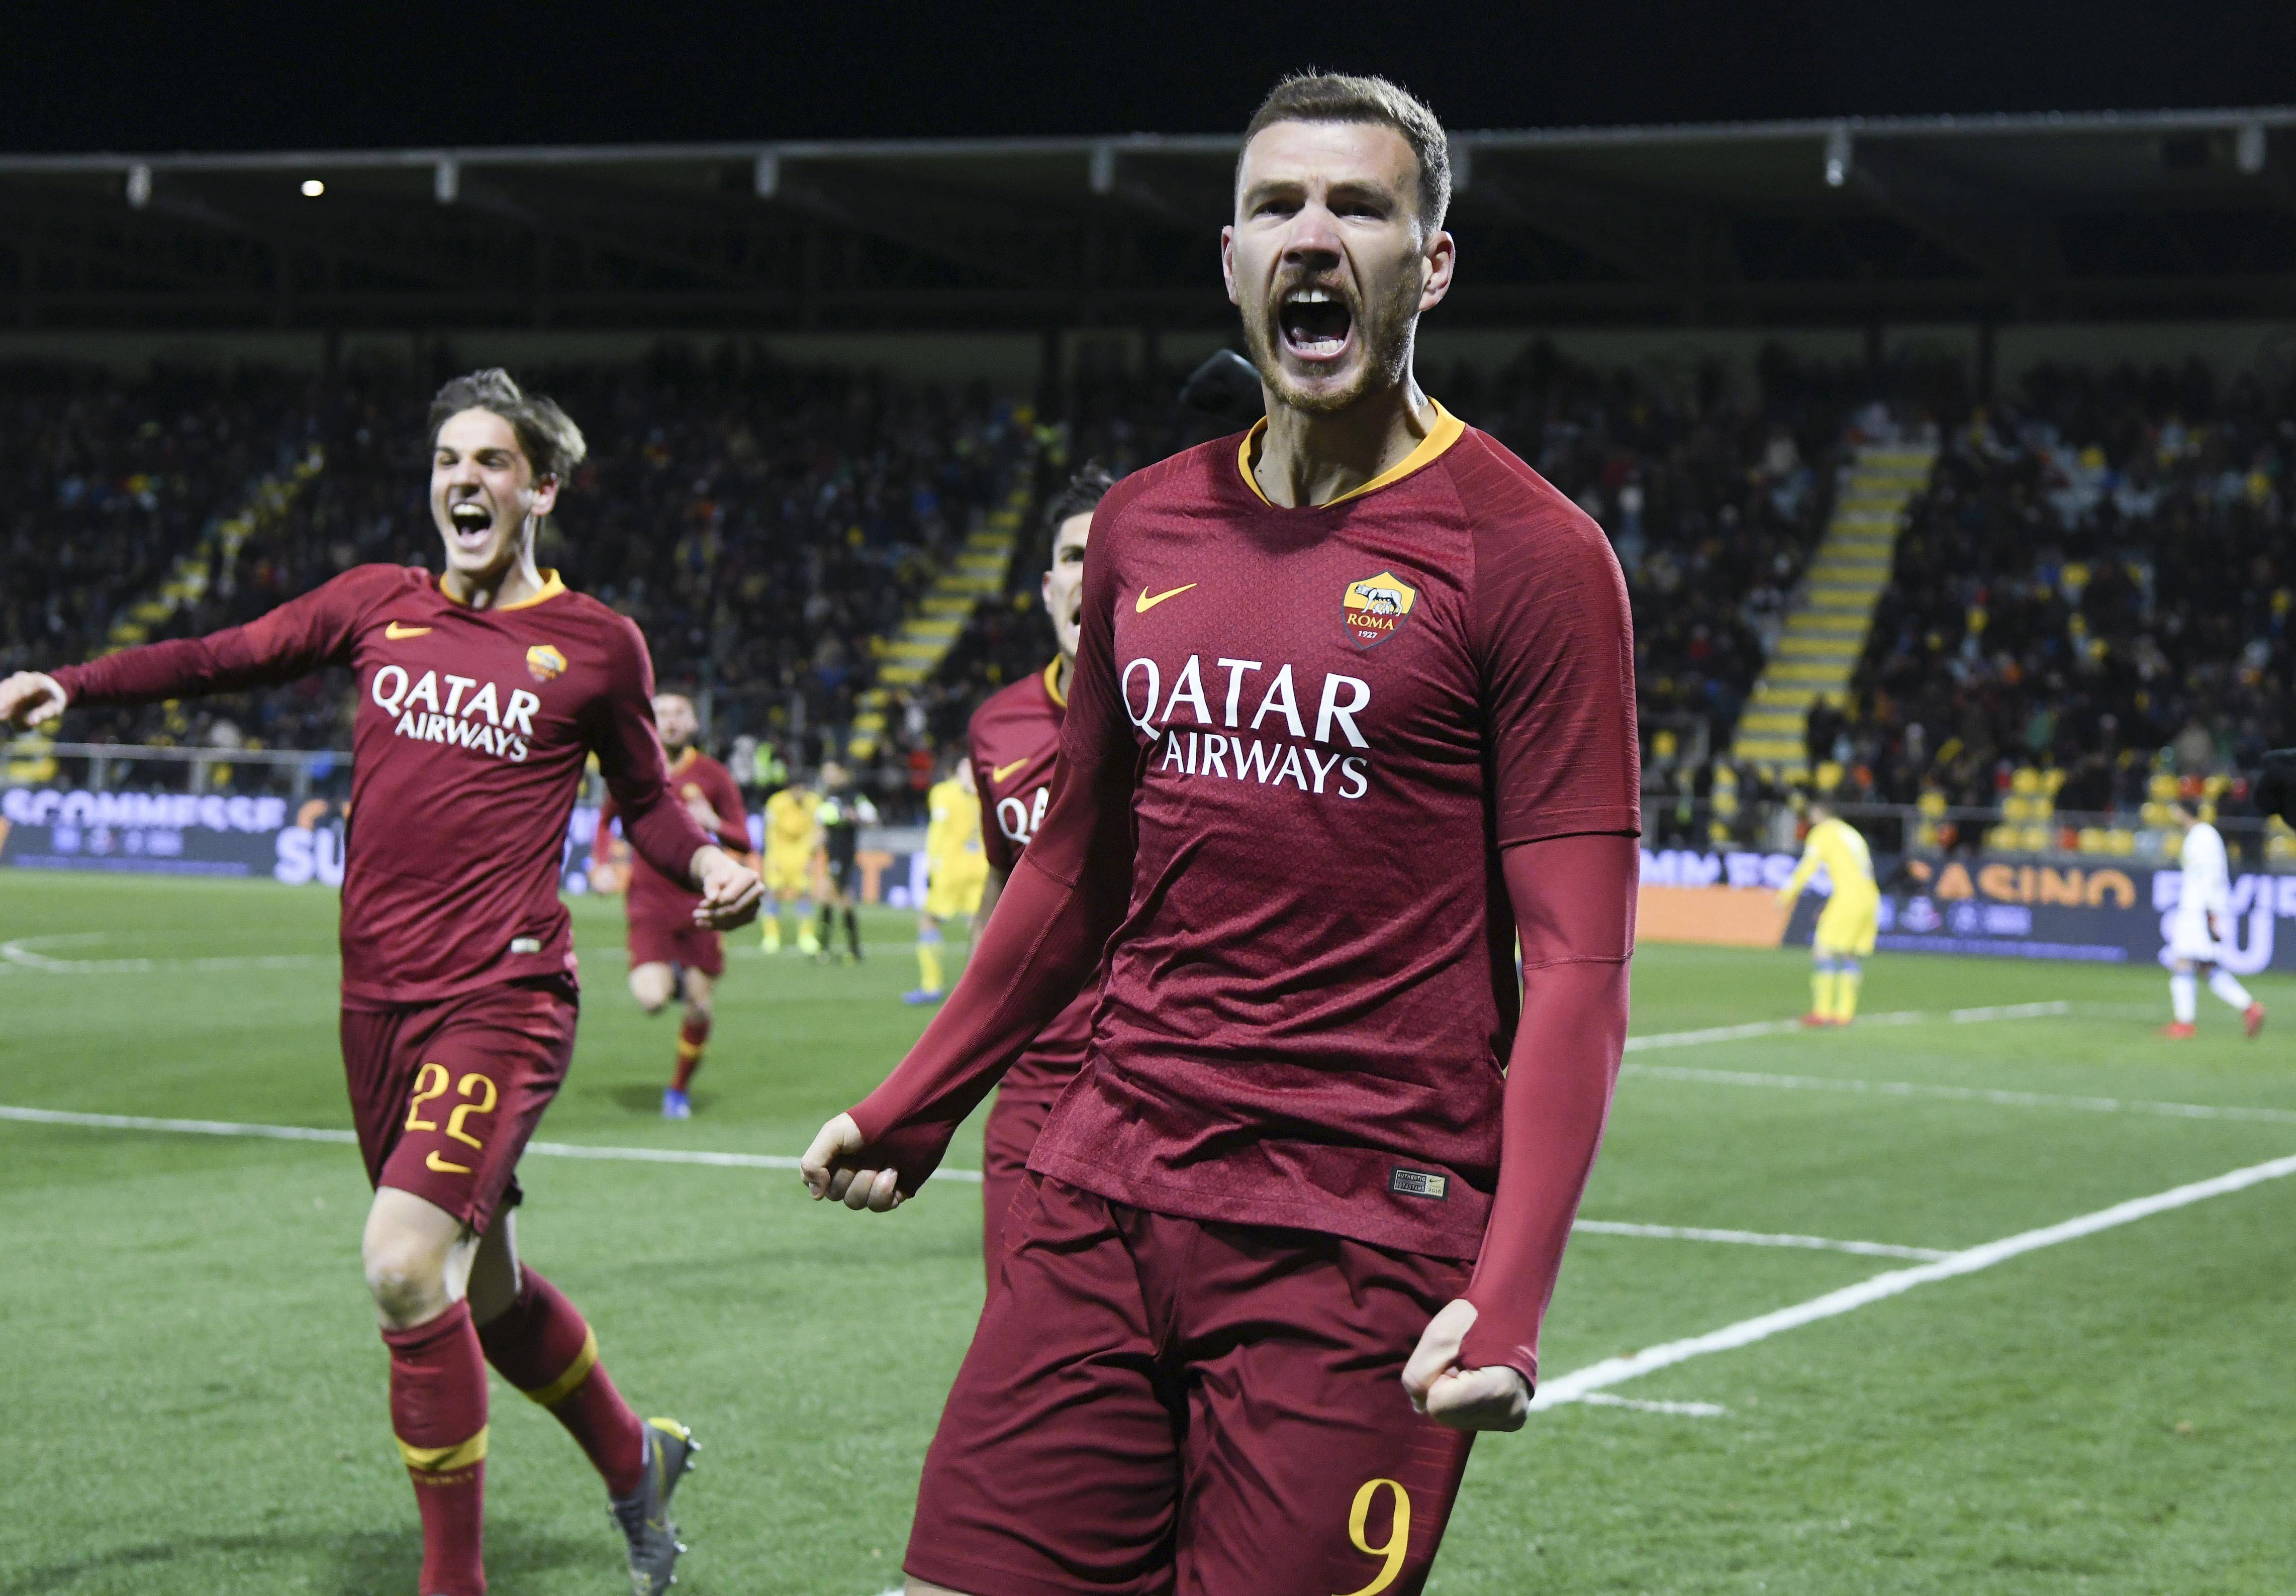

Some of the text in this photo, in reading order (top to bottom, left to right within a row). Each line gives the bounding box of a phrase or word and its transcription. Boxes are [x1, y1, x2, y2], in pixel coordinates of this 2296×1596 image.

[1347, 613, 1394, 630] ROMA
[1358, 630, 1378, 639] 1927
[371, 665, 541, 736] QATAR
[1121, 654, 1371, 749] QATAR
[395, 709, 528, 763] AIRWAYS
[1162, 730, 1368, 799] AIRWAYS
[405, 1063, 498, 1151] 22
[1398, 1172, 1425, 1181] AUTHENTIC
[1331, 1478, 1411, 1596] 9
